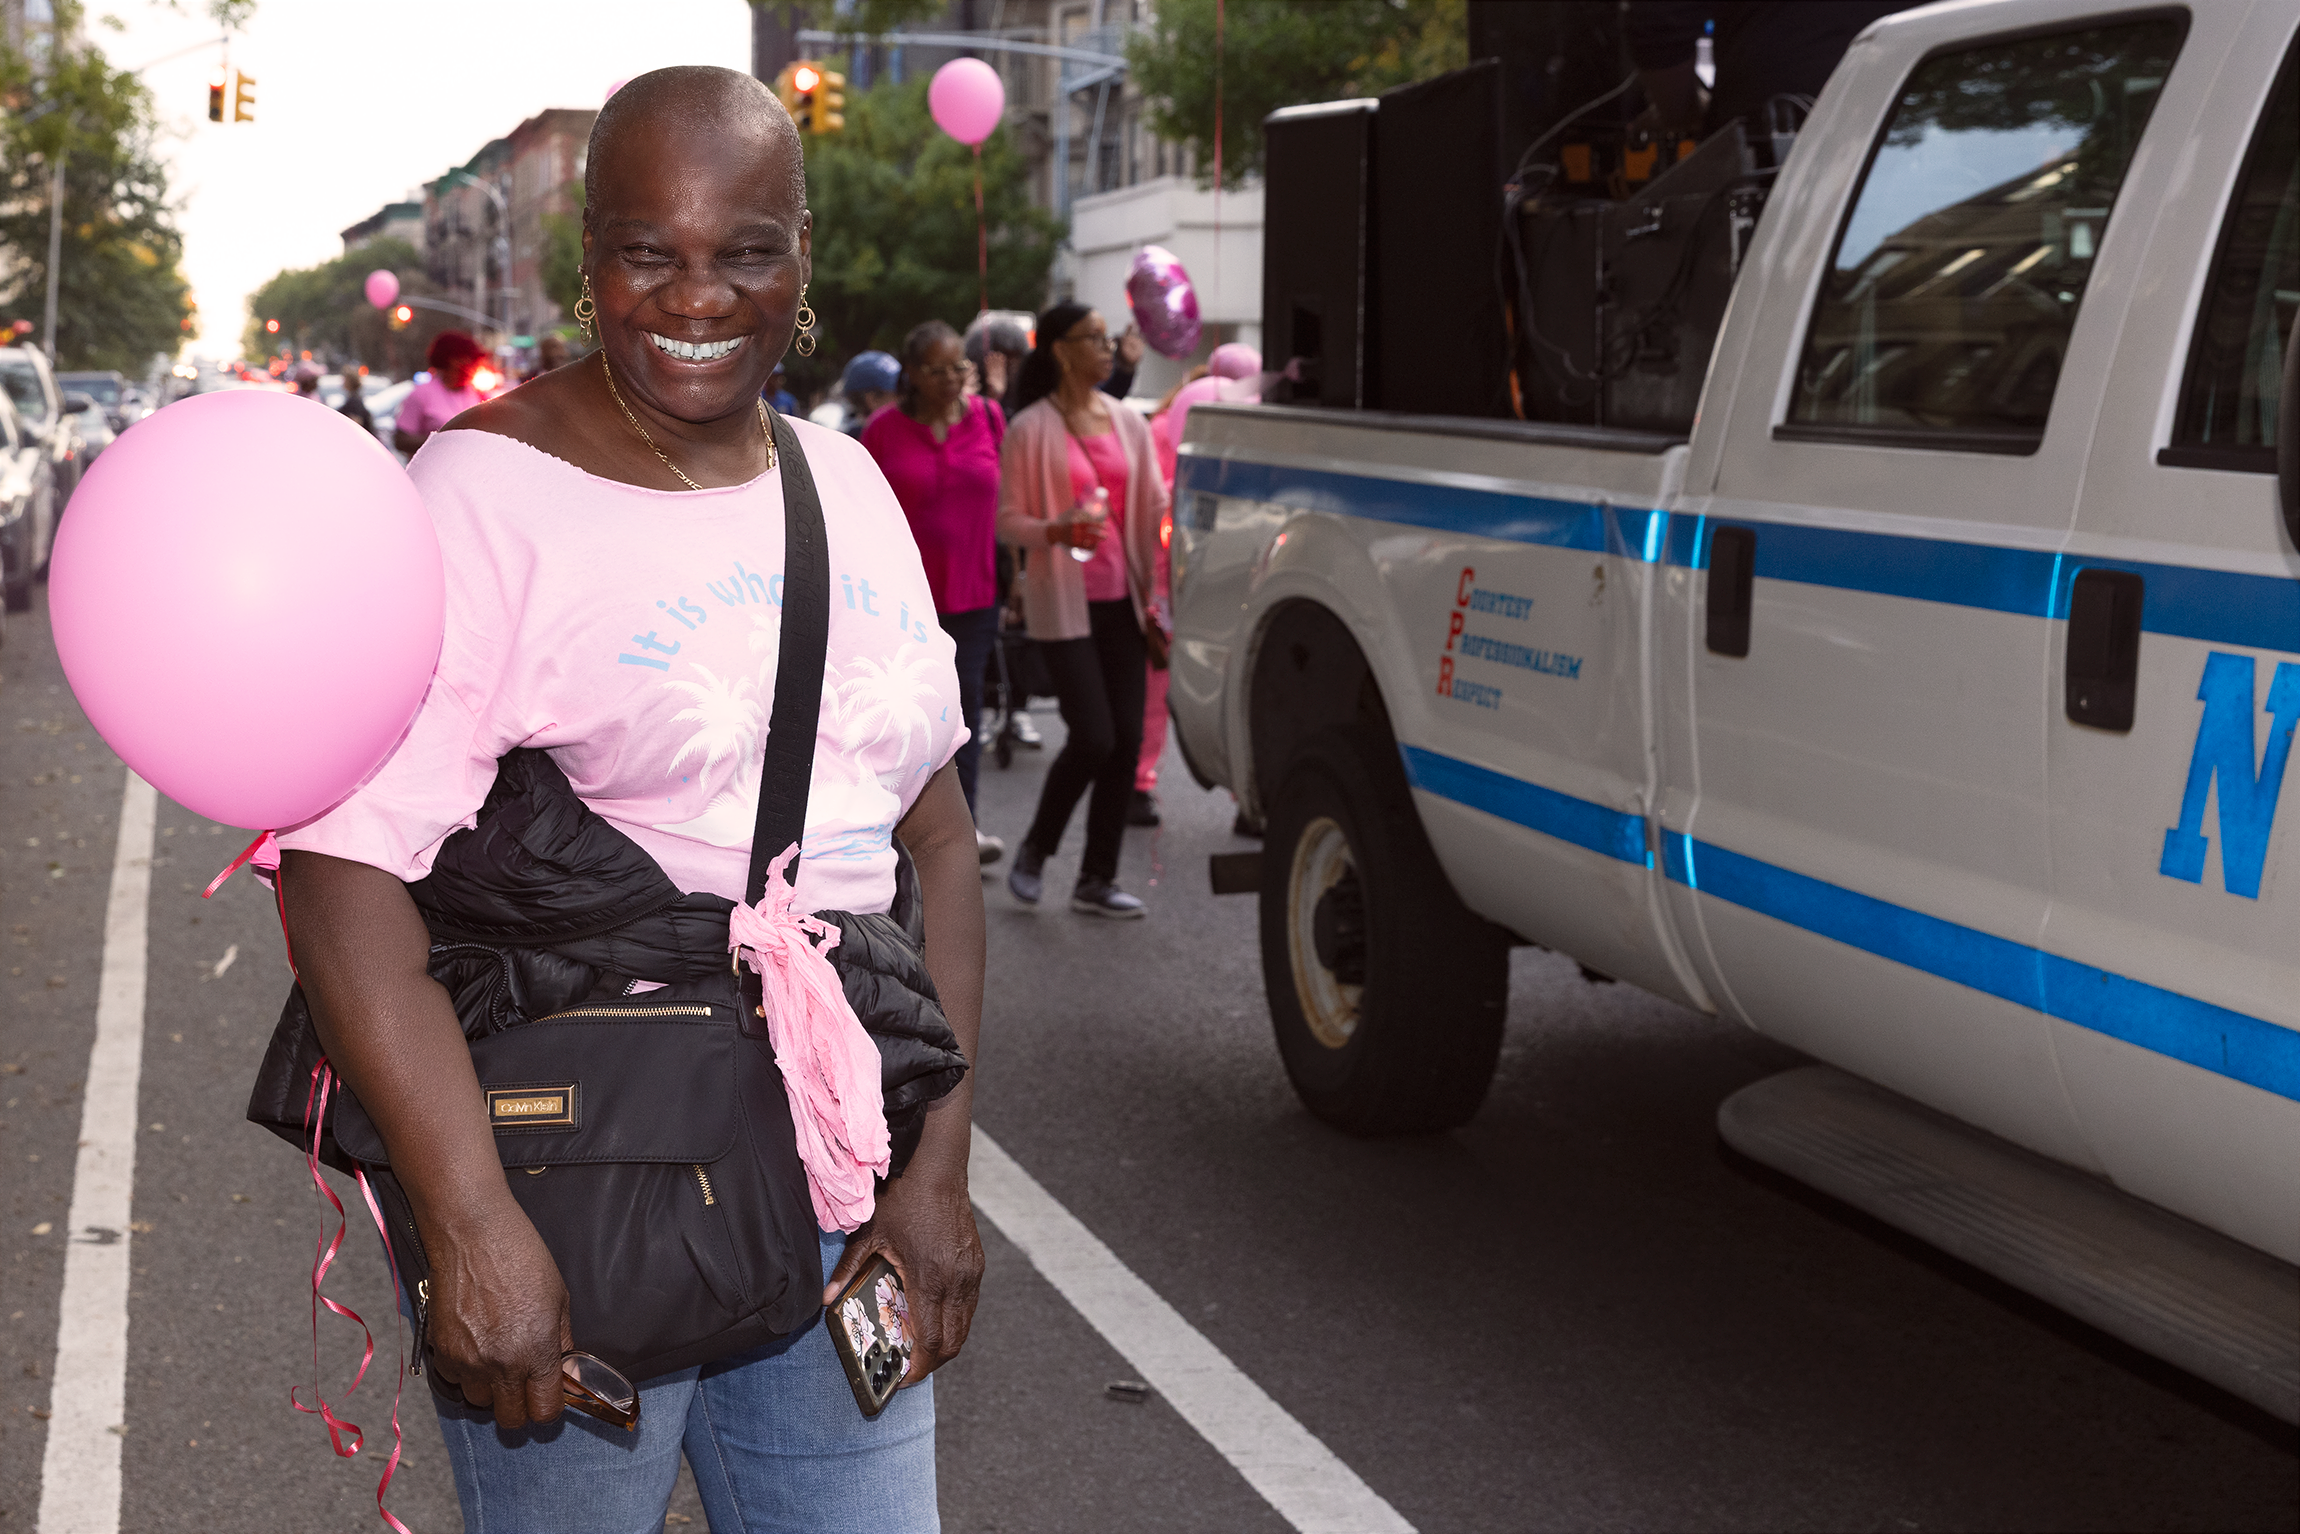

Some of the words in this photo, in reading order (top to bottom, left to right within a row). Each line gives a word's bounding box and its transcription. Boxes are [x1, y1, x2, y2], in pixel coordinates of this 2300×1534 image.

[618, 630, 681, 672] It
[656, 596, 707, 631] is
[706, 562, 786, 608] wha
[842, 574, 880, 617] it
[899, 601, 928, 643] is
[2160, 650, 2300, 900] N
[500, 1102, 533, 1113] Calvin
[533, 1100, 558, 1112] Klein
